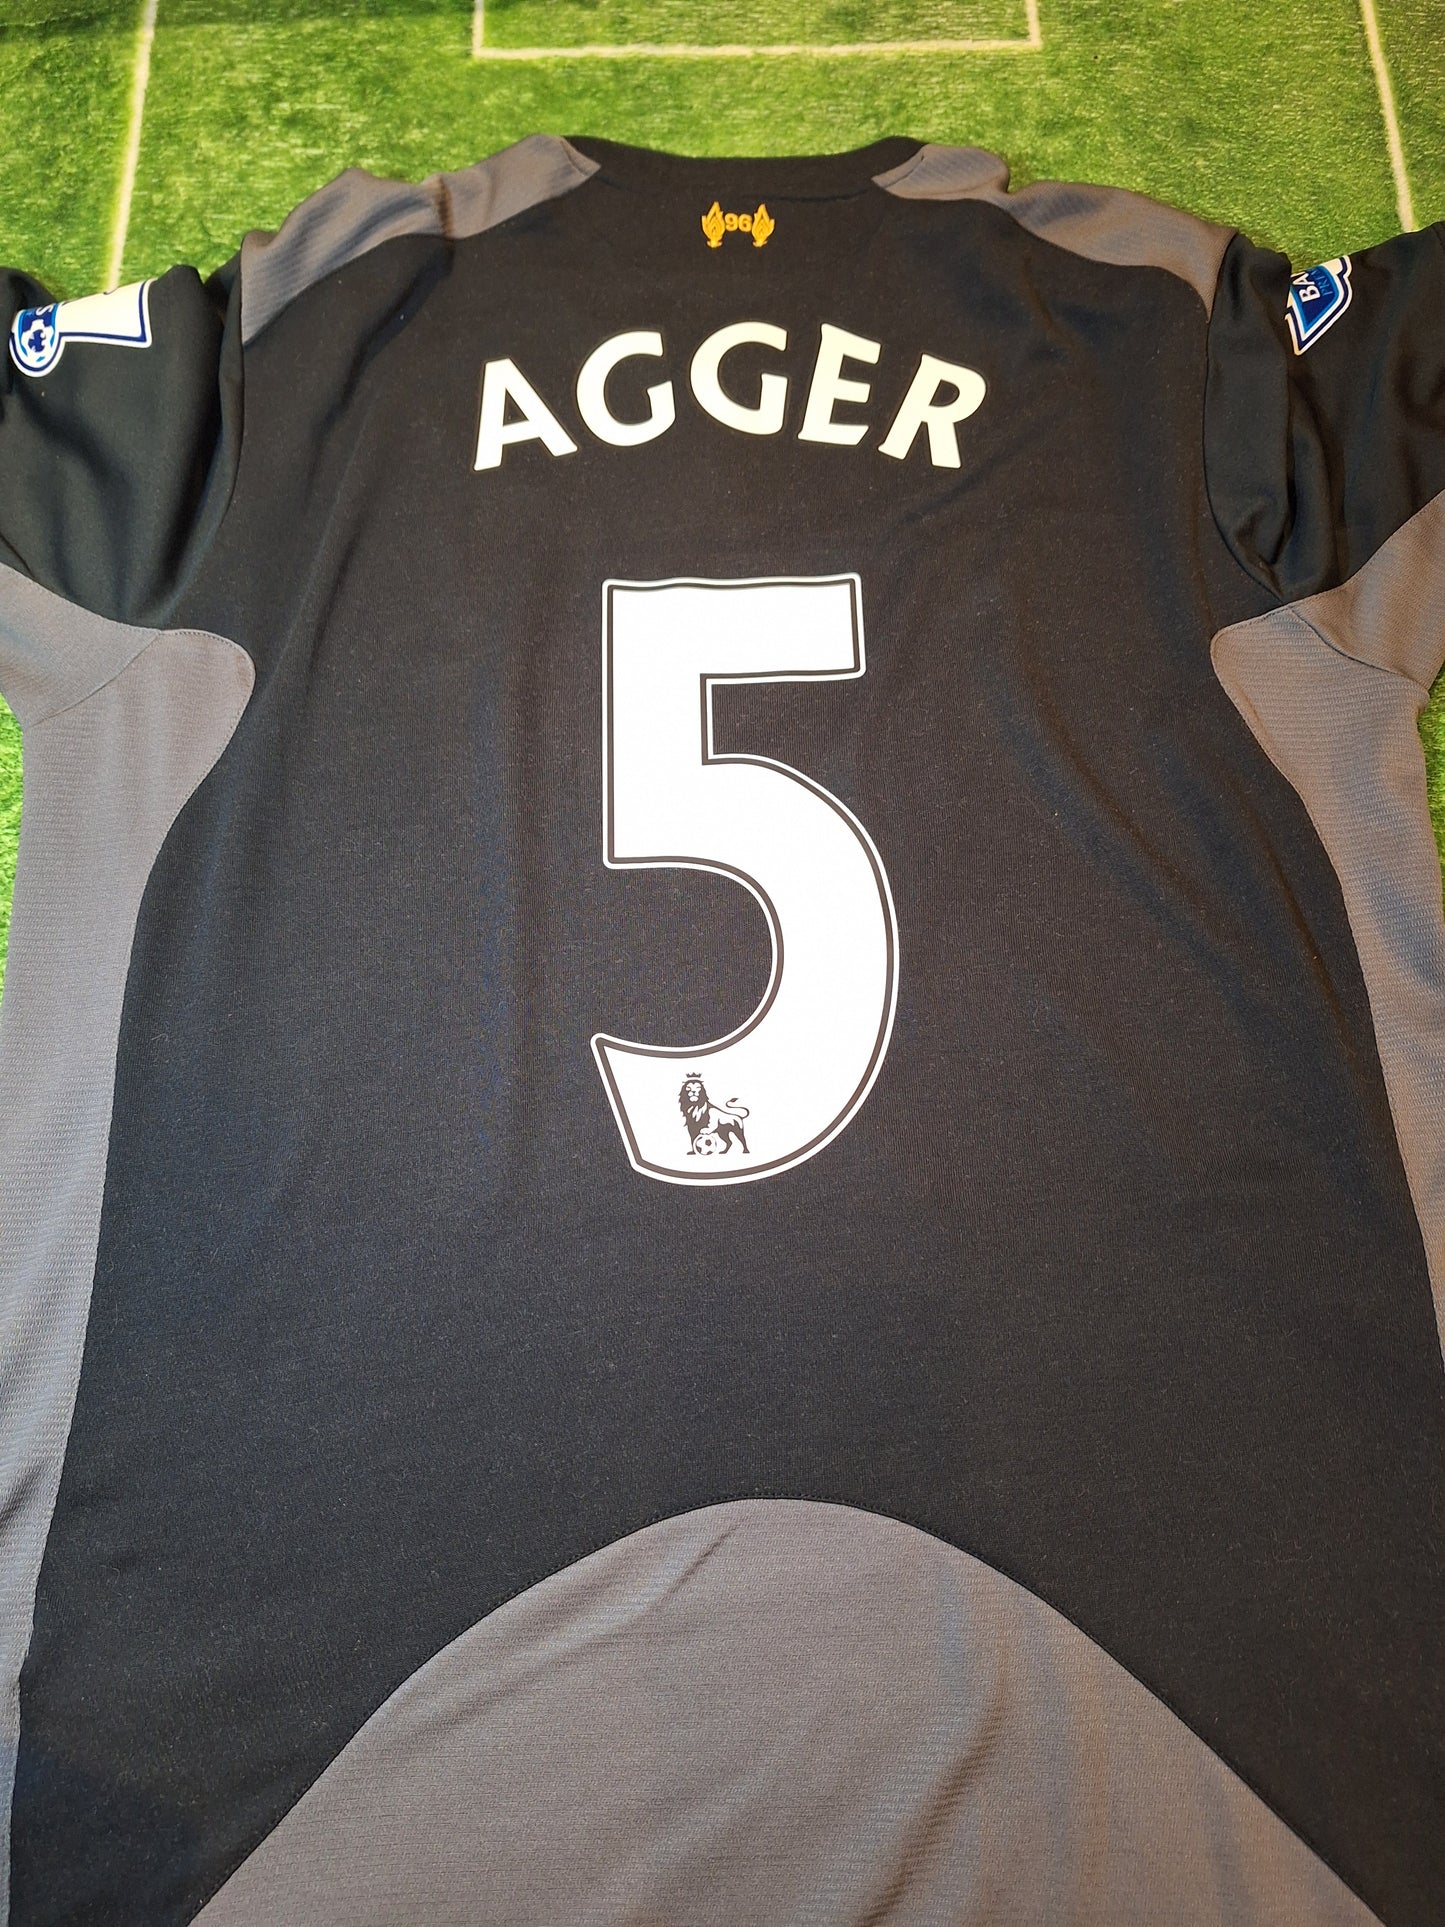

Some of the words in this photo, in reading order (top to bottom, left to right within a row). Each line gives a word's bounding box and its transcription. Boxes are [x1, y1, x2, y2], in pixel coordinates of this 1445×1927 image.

[724, 212, 753, 232] 96
[473, 321, 986, 471] AGGER
[589, 572, 900, 1187] 5
